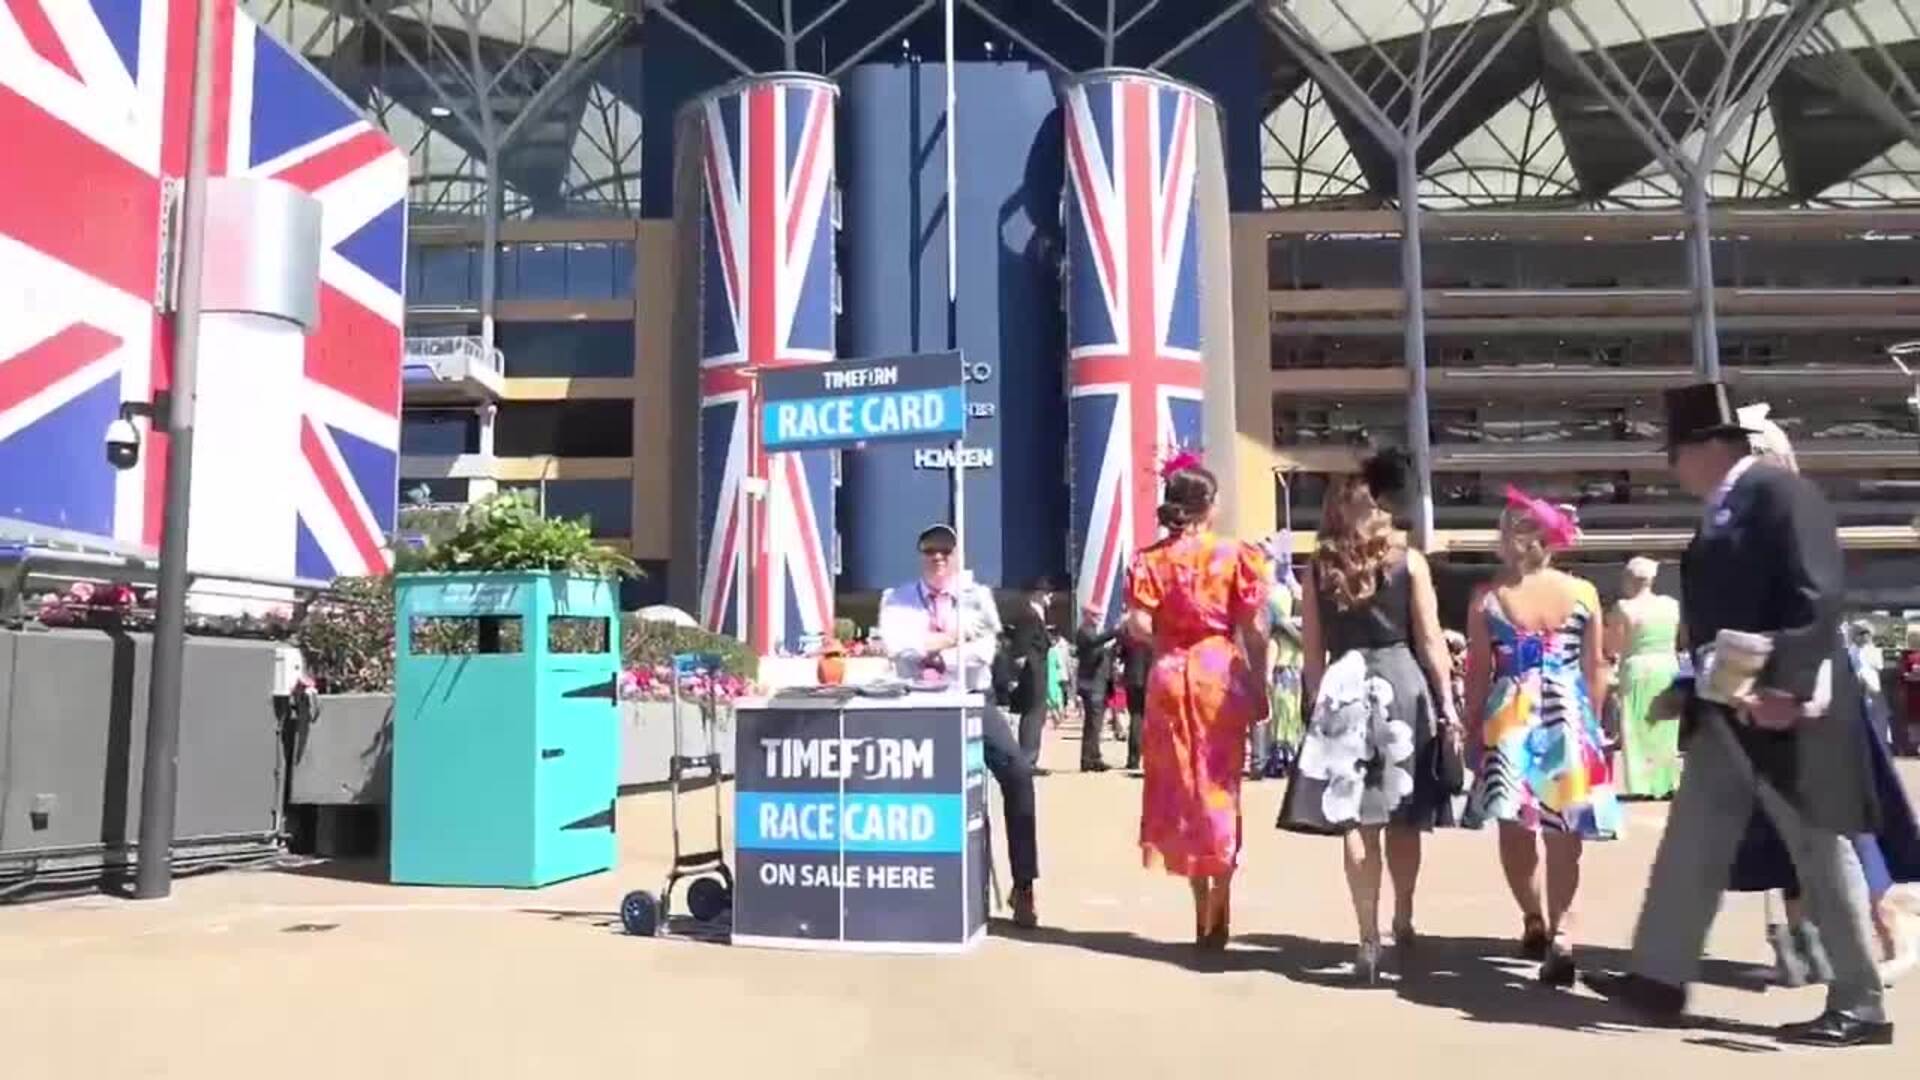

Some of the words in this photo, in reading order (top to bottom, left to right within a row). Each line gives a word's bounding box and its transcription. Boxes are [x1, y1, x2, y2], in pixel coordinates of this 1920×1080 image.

[822, 366, 898, 389] TIMEFORM
[778, 400, 855, 438] RACE
[860, 393, 944, 433] CARD
[760, 737, 934, 780] TIMEFORM
[759, 801, 834, 841] RACE
[843, 802, 935, 841] CARD
[760, 862, 795, 886] ON
[801, 864, 860, 888] SALE
[867, 866, 935, 889] HERE
